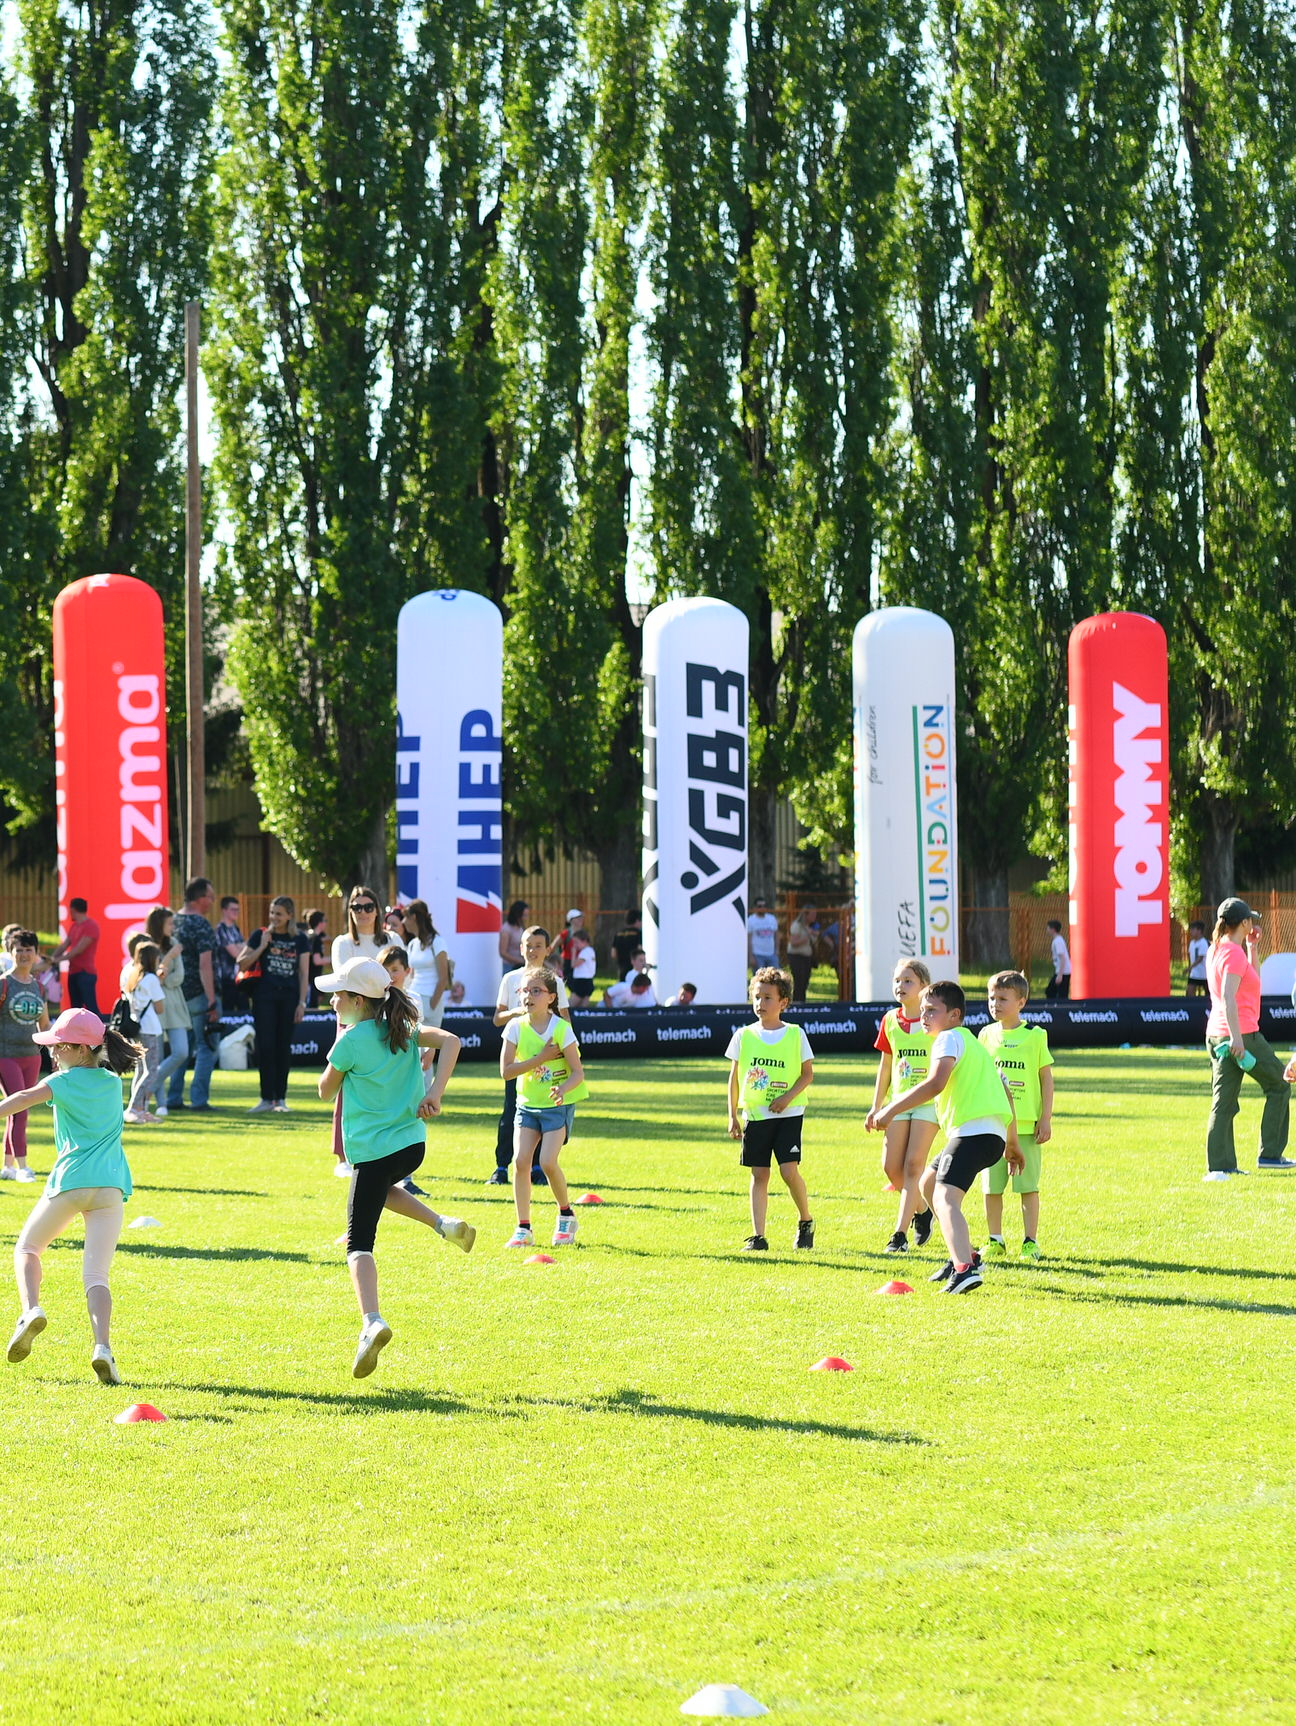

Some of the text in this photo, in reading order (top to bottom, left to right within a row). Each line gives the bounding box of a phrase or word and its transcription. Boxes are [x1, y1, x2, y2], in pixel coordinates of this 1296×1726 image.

[456, 709, 503, 855] HEP
[1112, 680, 1163, 938] TOMMY
[897, 900, 917, 957] UEFA
[1068, 1010, 1119, 1023] telemach
[1140, 1009, 1190, 1022] telemach
[657, 1025, 712, 1041] telemach
[805, 1019, 857, 1034] telemach
[580, 1028, 637, 1044] telemach
[750, 1057, 786, 1069] Joma
